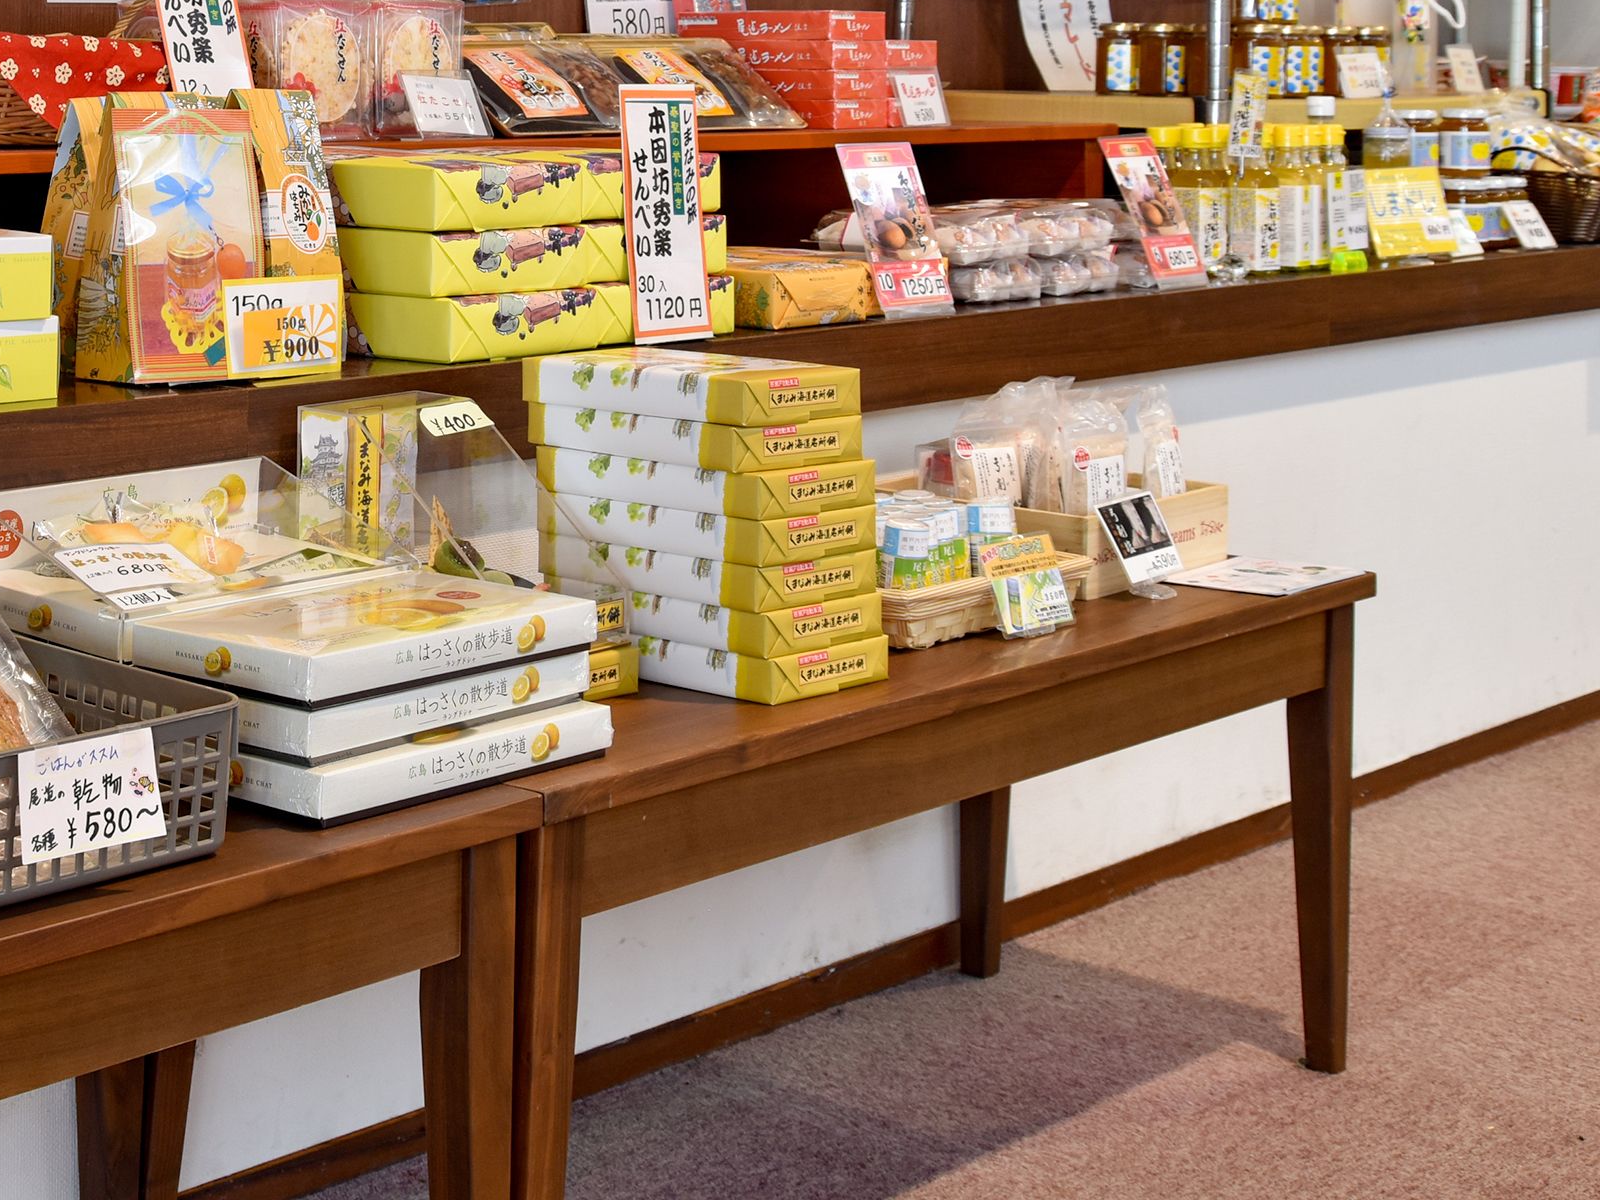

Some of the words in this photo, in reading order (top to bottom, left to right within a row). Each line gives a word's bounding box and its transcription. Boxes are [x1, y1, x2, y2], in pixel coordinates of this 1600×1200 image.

[611, 7, 666, 34] 580円
[334, 18, 348, 83] 紅たこせん
[668, 105, 683, 211] 碁聖の誉れ高き
[682, 109, 698, 226] しまなみの旅
[648, 105, 673, 258] 本因坊秀策
[632, 147, 651, 258] せんべい
[878, 272, 894, 291] 10
[276, 316, 307, 333] 150g
[263, 335, 320, 362] ¥900
[116, 562, 172, 577] 680円
[175, 649, 204, 662] HASSAKU
[394, 649, 414, 665] 広島
[418, 625, 514, 663] はっさくの散歩道
[392, 704, 412, 721] 広島
[415, 676, 508, 716] はっさくの散歩道
[36, 745, 119, 776] ごはんがススム
[407, 764, 428, 781] 広島
[430, 734, 527, 776] はっさくの散歩道
[28, 782, 66, 810] 尾道の
[71, 772, 123, 811] 乾物
[31, 827, 59, 853] 各種
